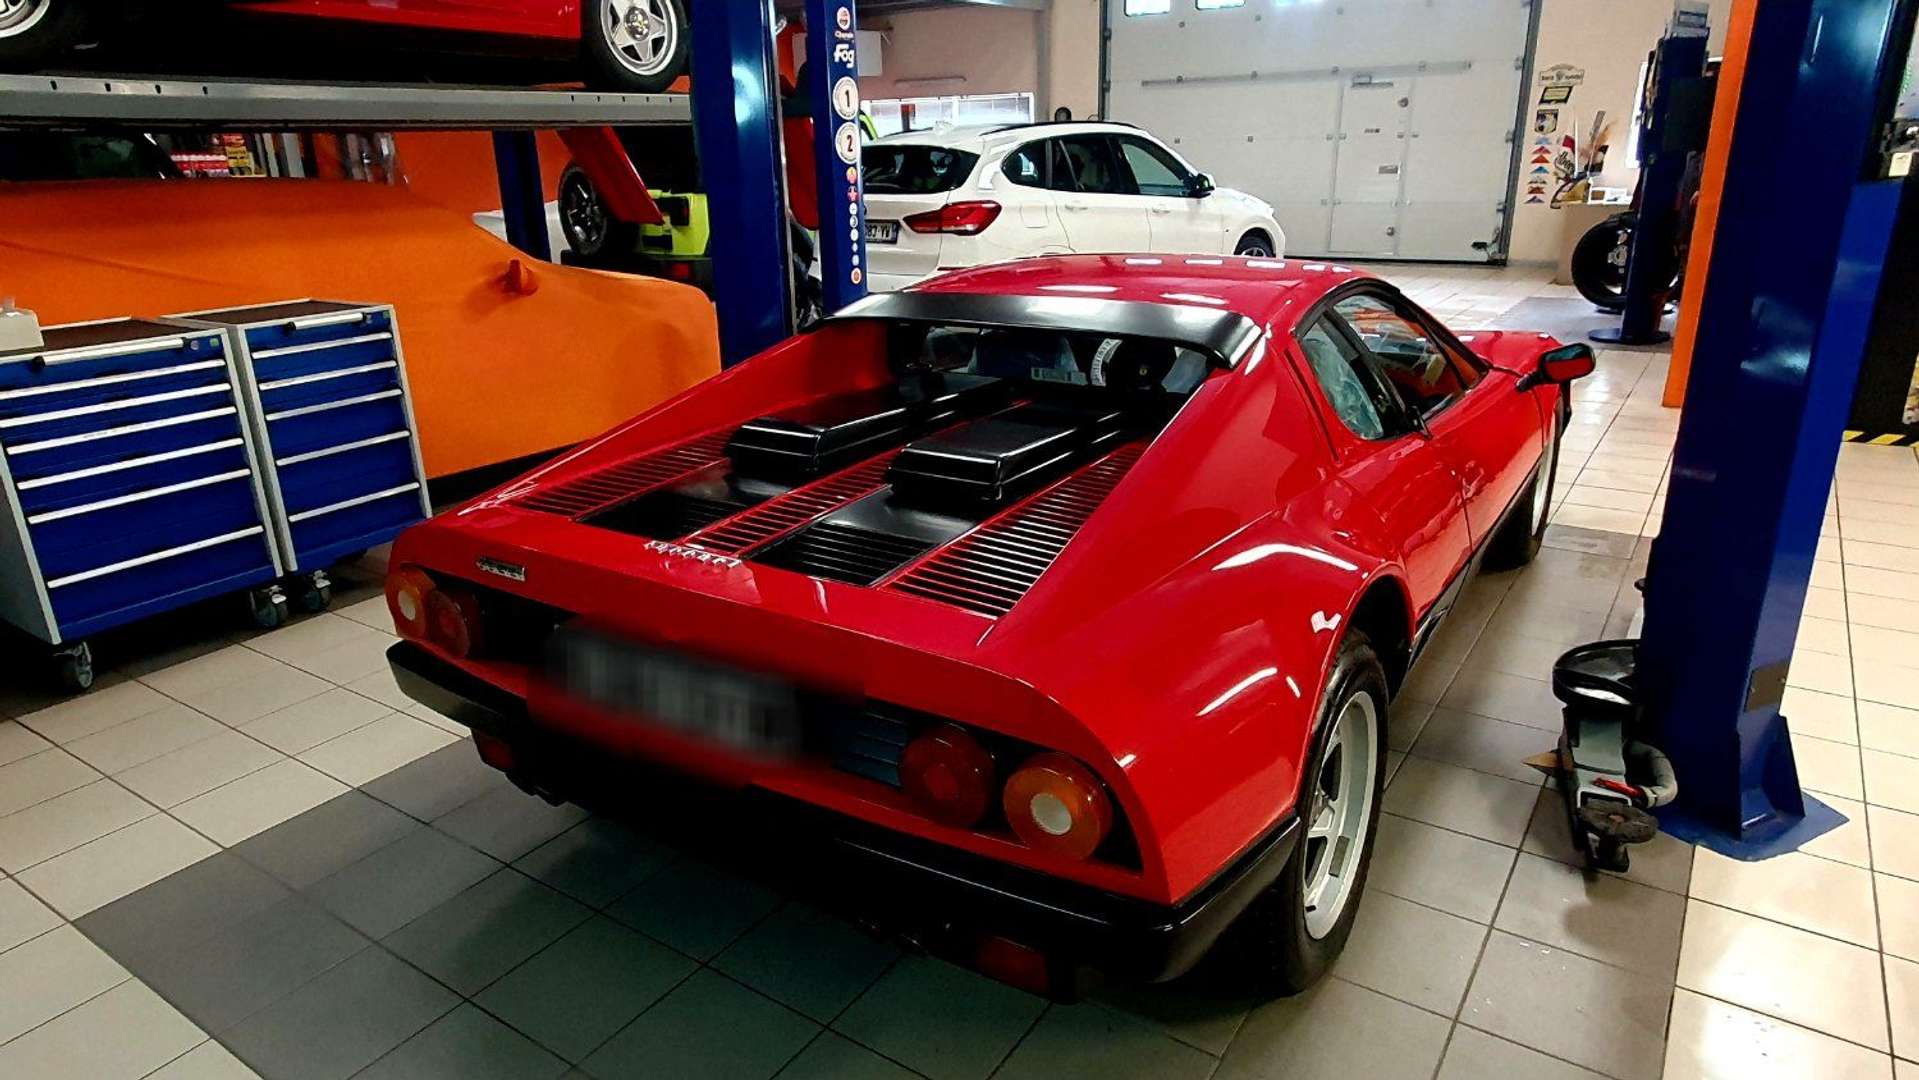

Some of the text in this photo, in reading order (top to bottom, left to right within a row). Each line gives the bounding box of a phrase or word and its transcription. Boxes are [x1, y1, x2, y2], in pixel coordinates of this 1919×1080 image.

[833, 43, 855, 69] Fog
[844, 89, 851, 108] 1
[846, 134, 854, 153] 2
